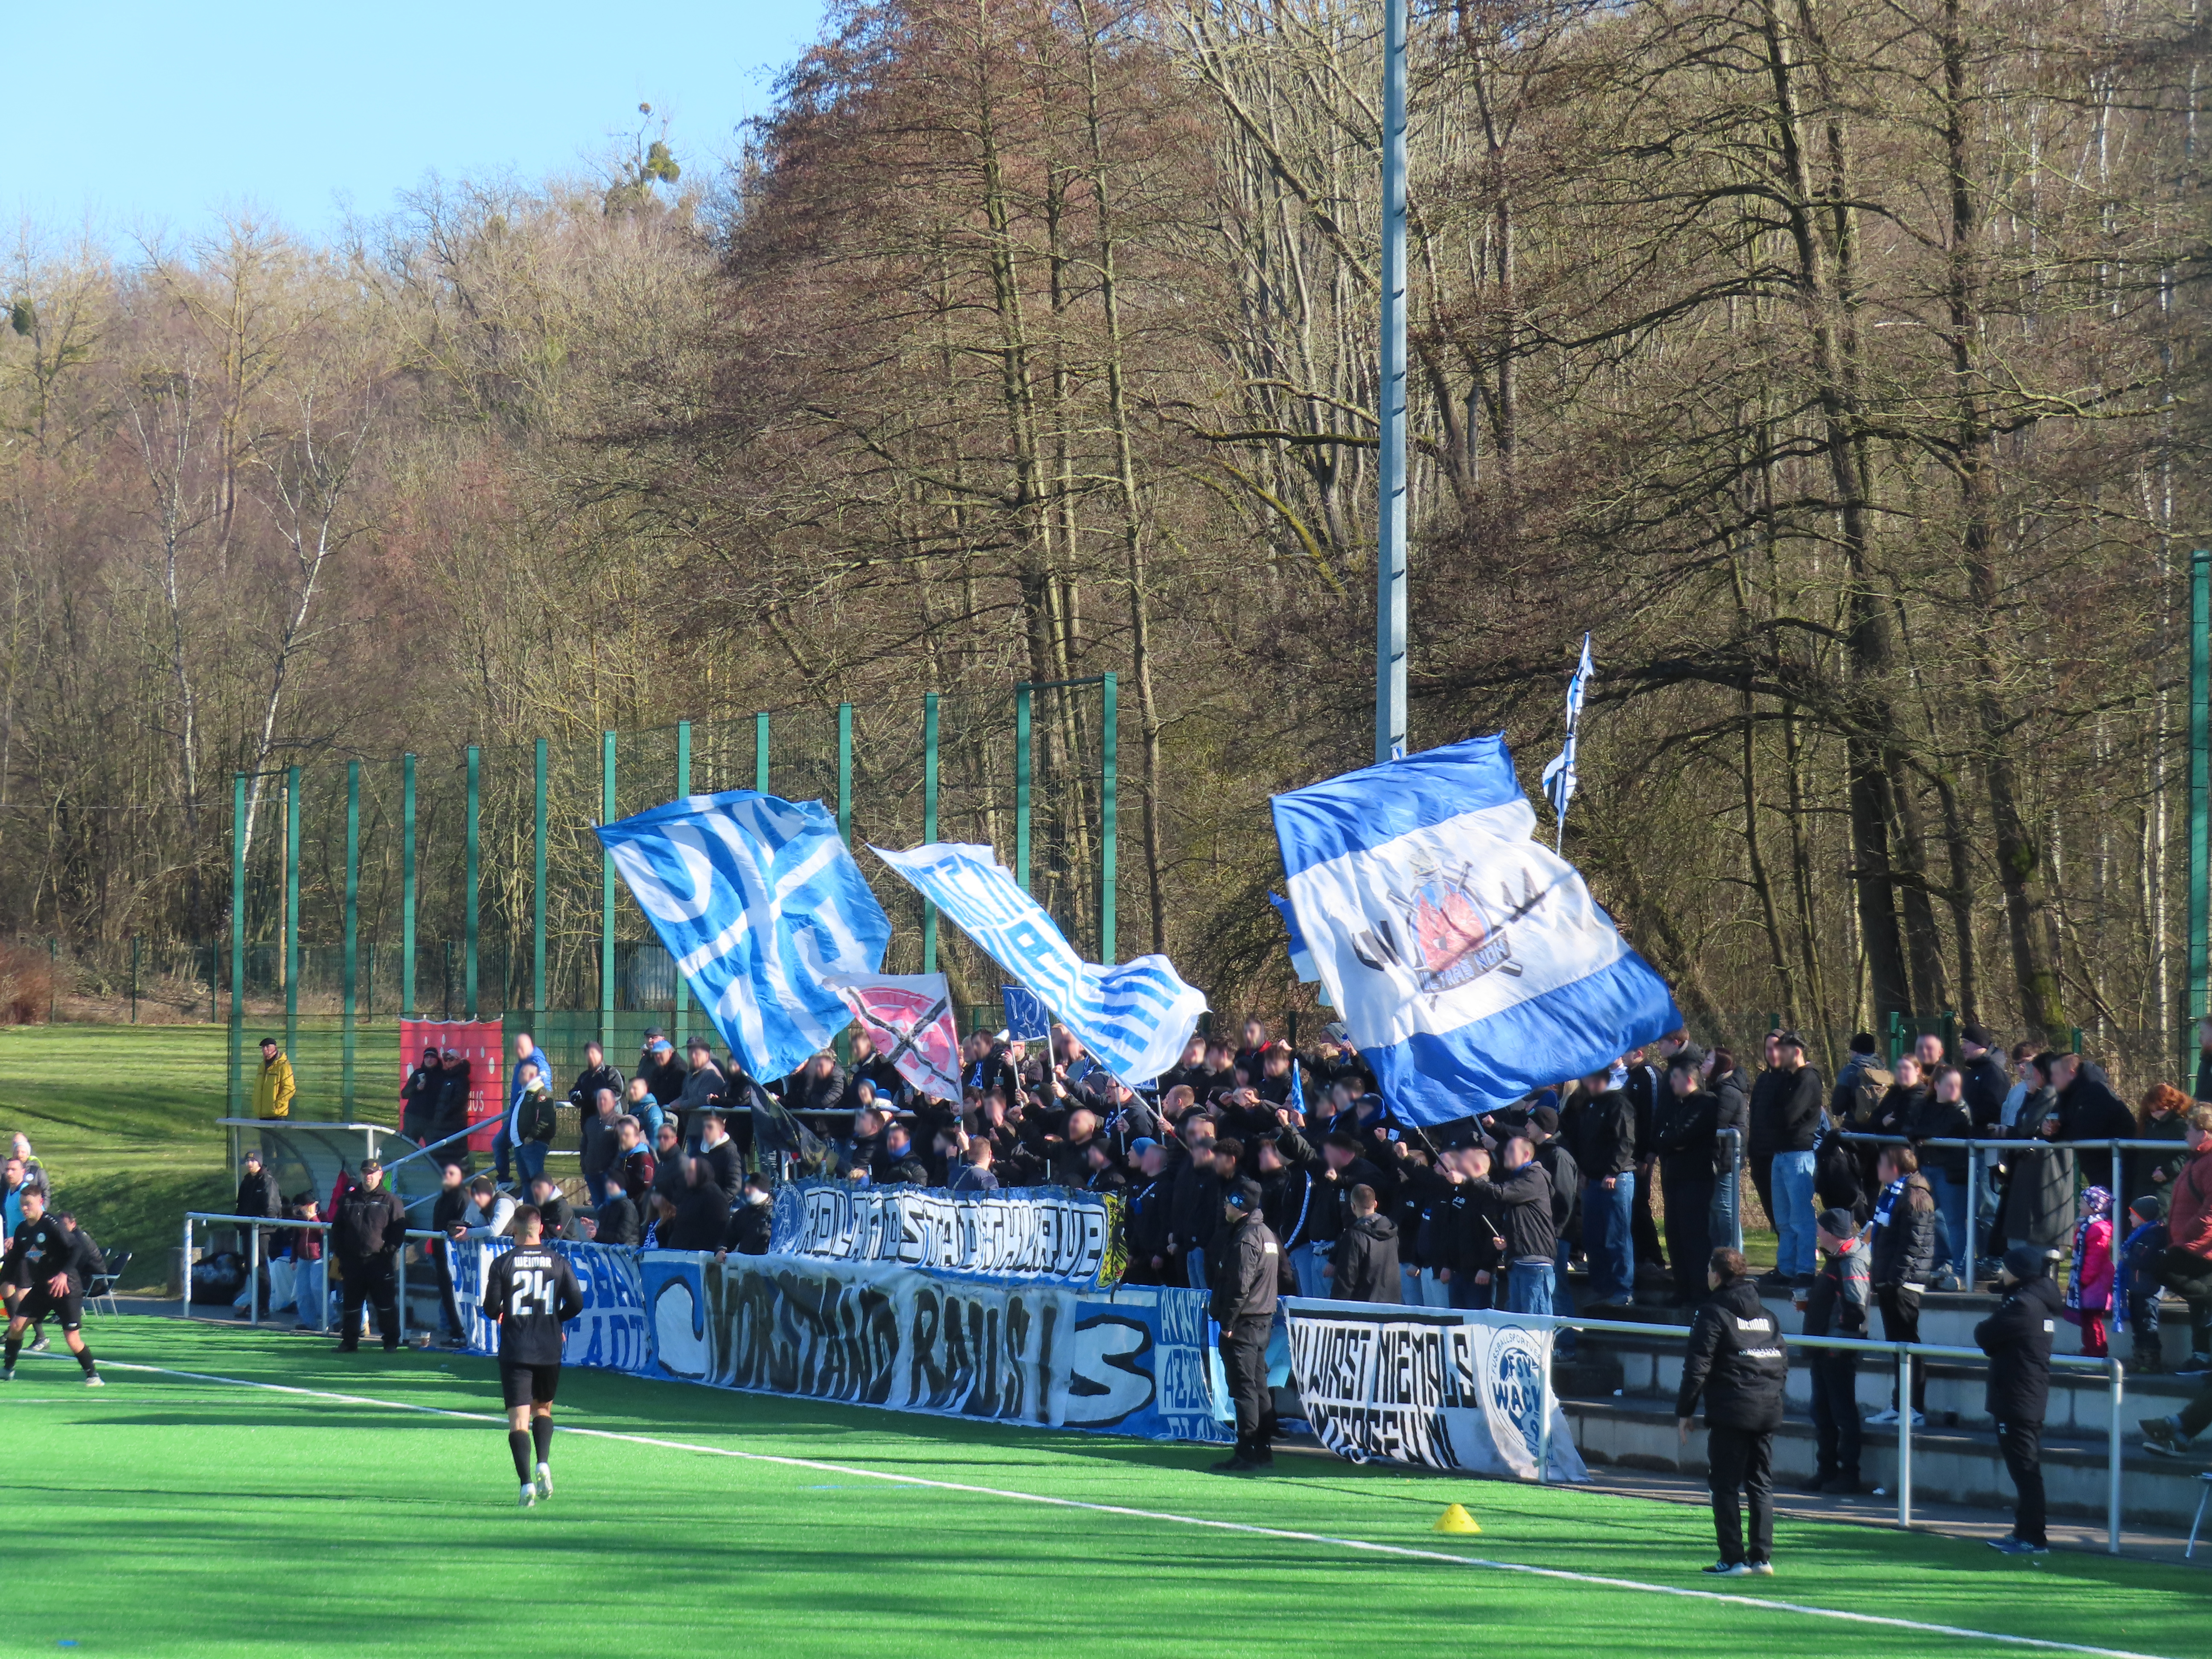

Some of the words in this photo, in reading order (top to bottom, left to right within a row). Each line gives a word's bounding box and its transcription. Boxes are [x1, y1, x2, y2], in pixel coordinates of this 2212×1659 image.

[1420, 957, 1475, 992] ULTRAS
[514, 1256, 552, 1268] WEIMAR
[512, 1270, 554, 1315] 24
[1736, 1316, 1770, 1332] WEIMAR
[1308, 1325, 1371, 1401] WIRST
[1373, 1330, 1478, 1408] NIEMALS
[1508, 1353, 1533, 1378] FSV
